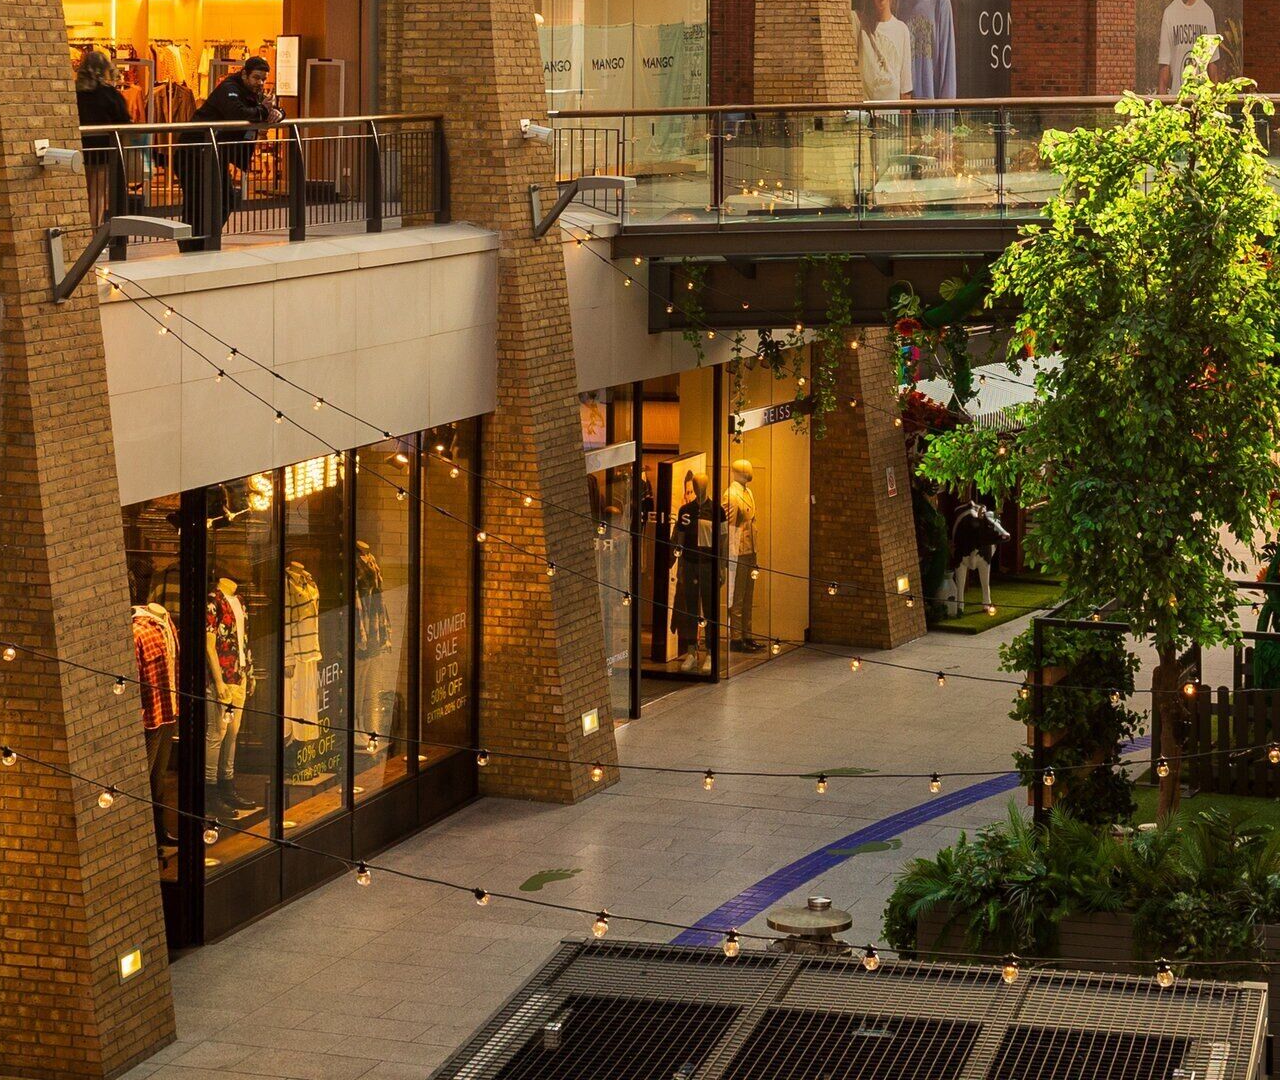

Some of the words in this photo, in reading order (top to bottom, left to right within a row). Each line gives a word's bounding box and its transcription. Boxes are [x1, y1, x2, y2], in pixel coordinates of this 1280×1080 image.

[544, 60, 572, 73] ANGO
[592, 57, 625, 70] MANGO
[643, 56, 675, 69] MANGO
[763, 405, 791, 424] REISS
[427, 612, 467, 642] SUMMER
[436, 636, 458, 660] SALE
[436, 667, 446, 683] UP
[448, 661, 459, 677] TO
[431, 684, 447, 705] 50%
[448, 677, 463, 697] OFF
[297, 743, 316, 766] 50%
[319, 733, 336, 756] OFF
